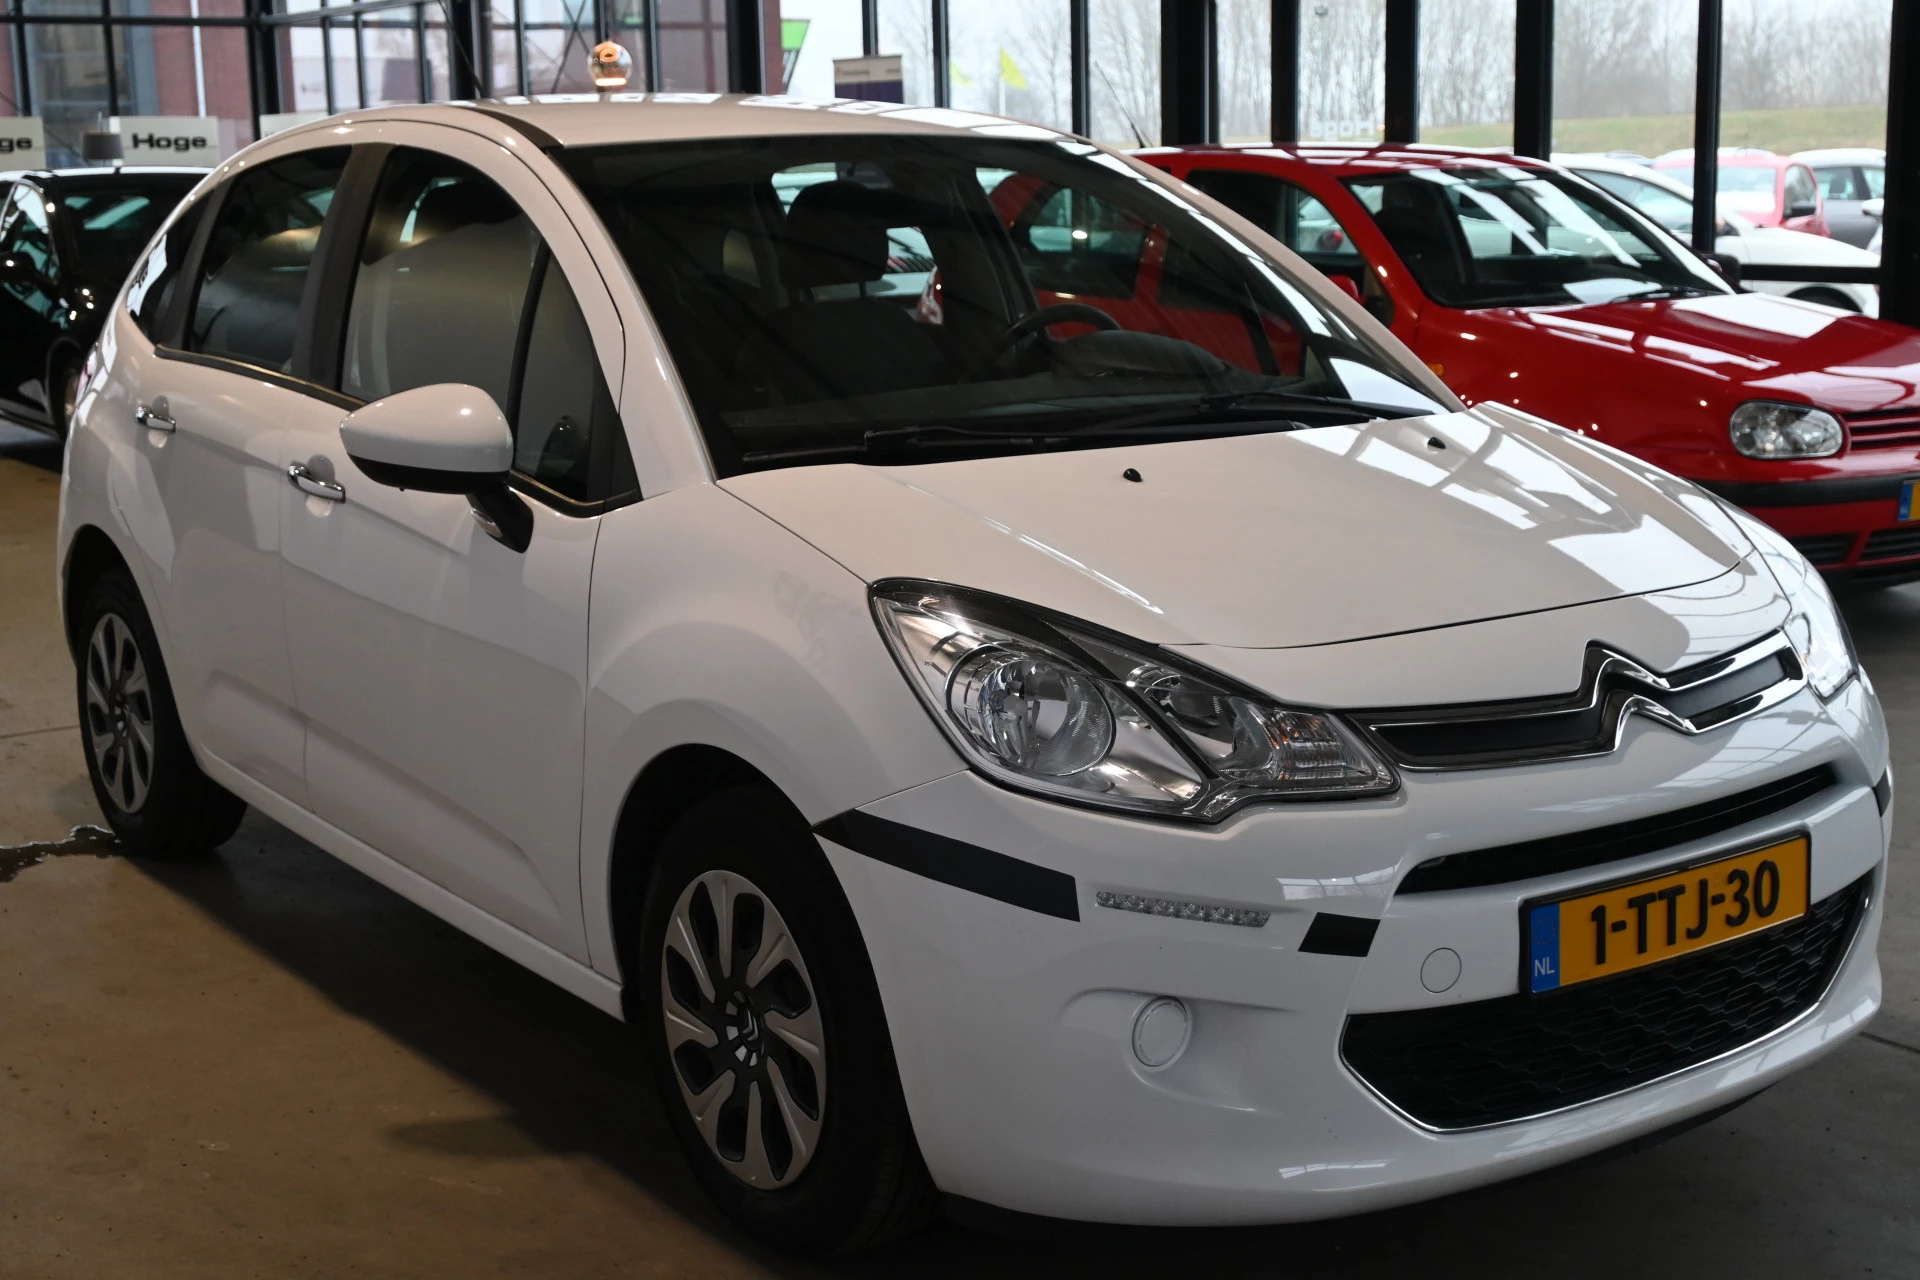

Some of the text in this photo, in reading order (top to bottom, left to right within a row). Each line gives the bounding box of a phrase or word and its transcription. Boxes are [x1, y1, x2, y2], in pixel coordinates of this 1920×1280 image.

[131, 132, 207, 152] Hoge
[1590, 859, 1781, 966] 1-TTJ-30
[1534, 956, 1556, 977] NL
